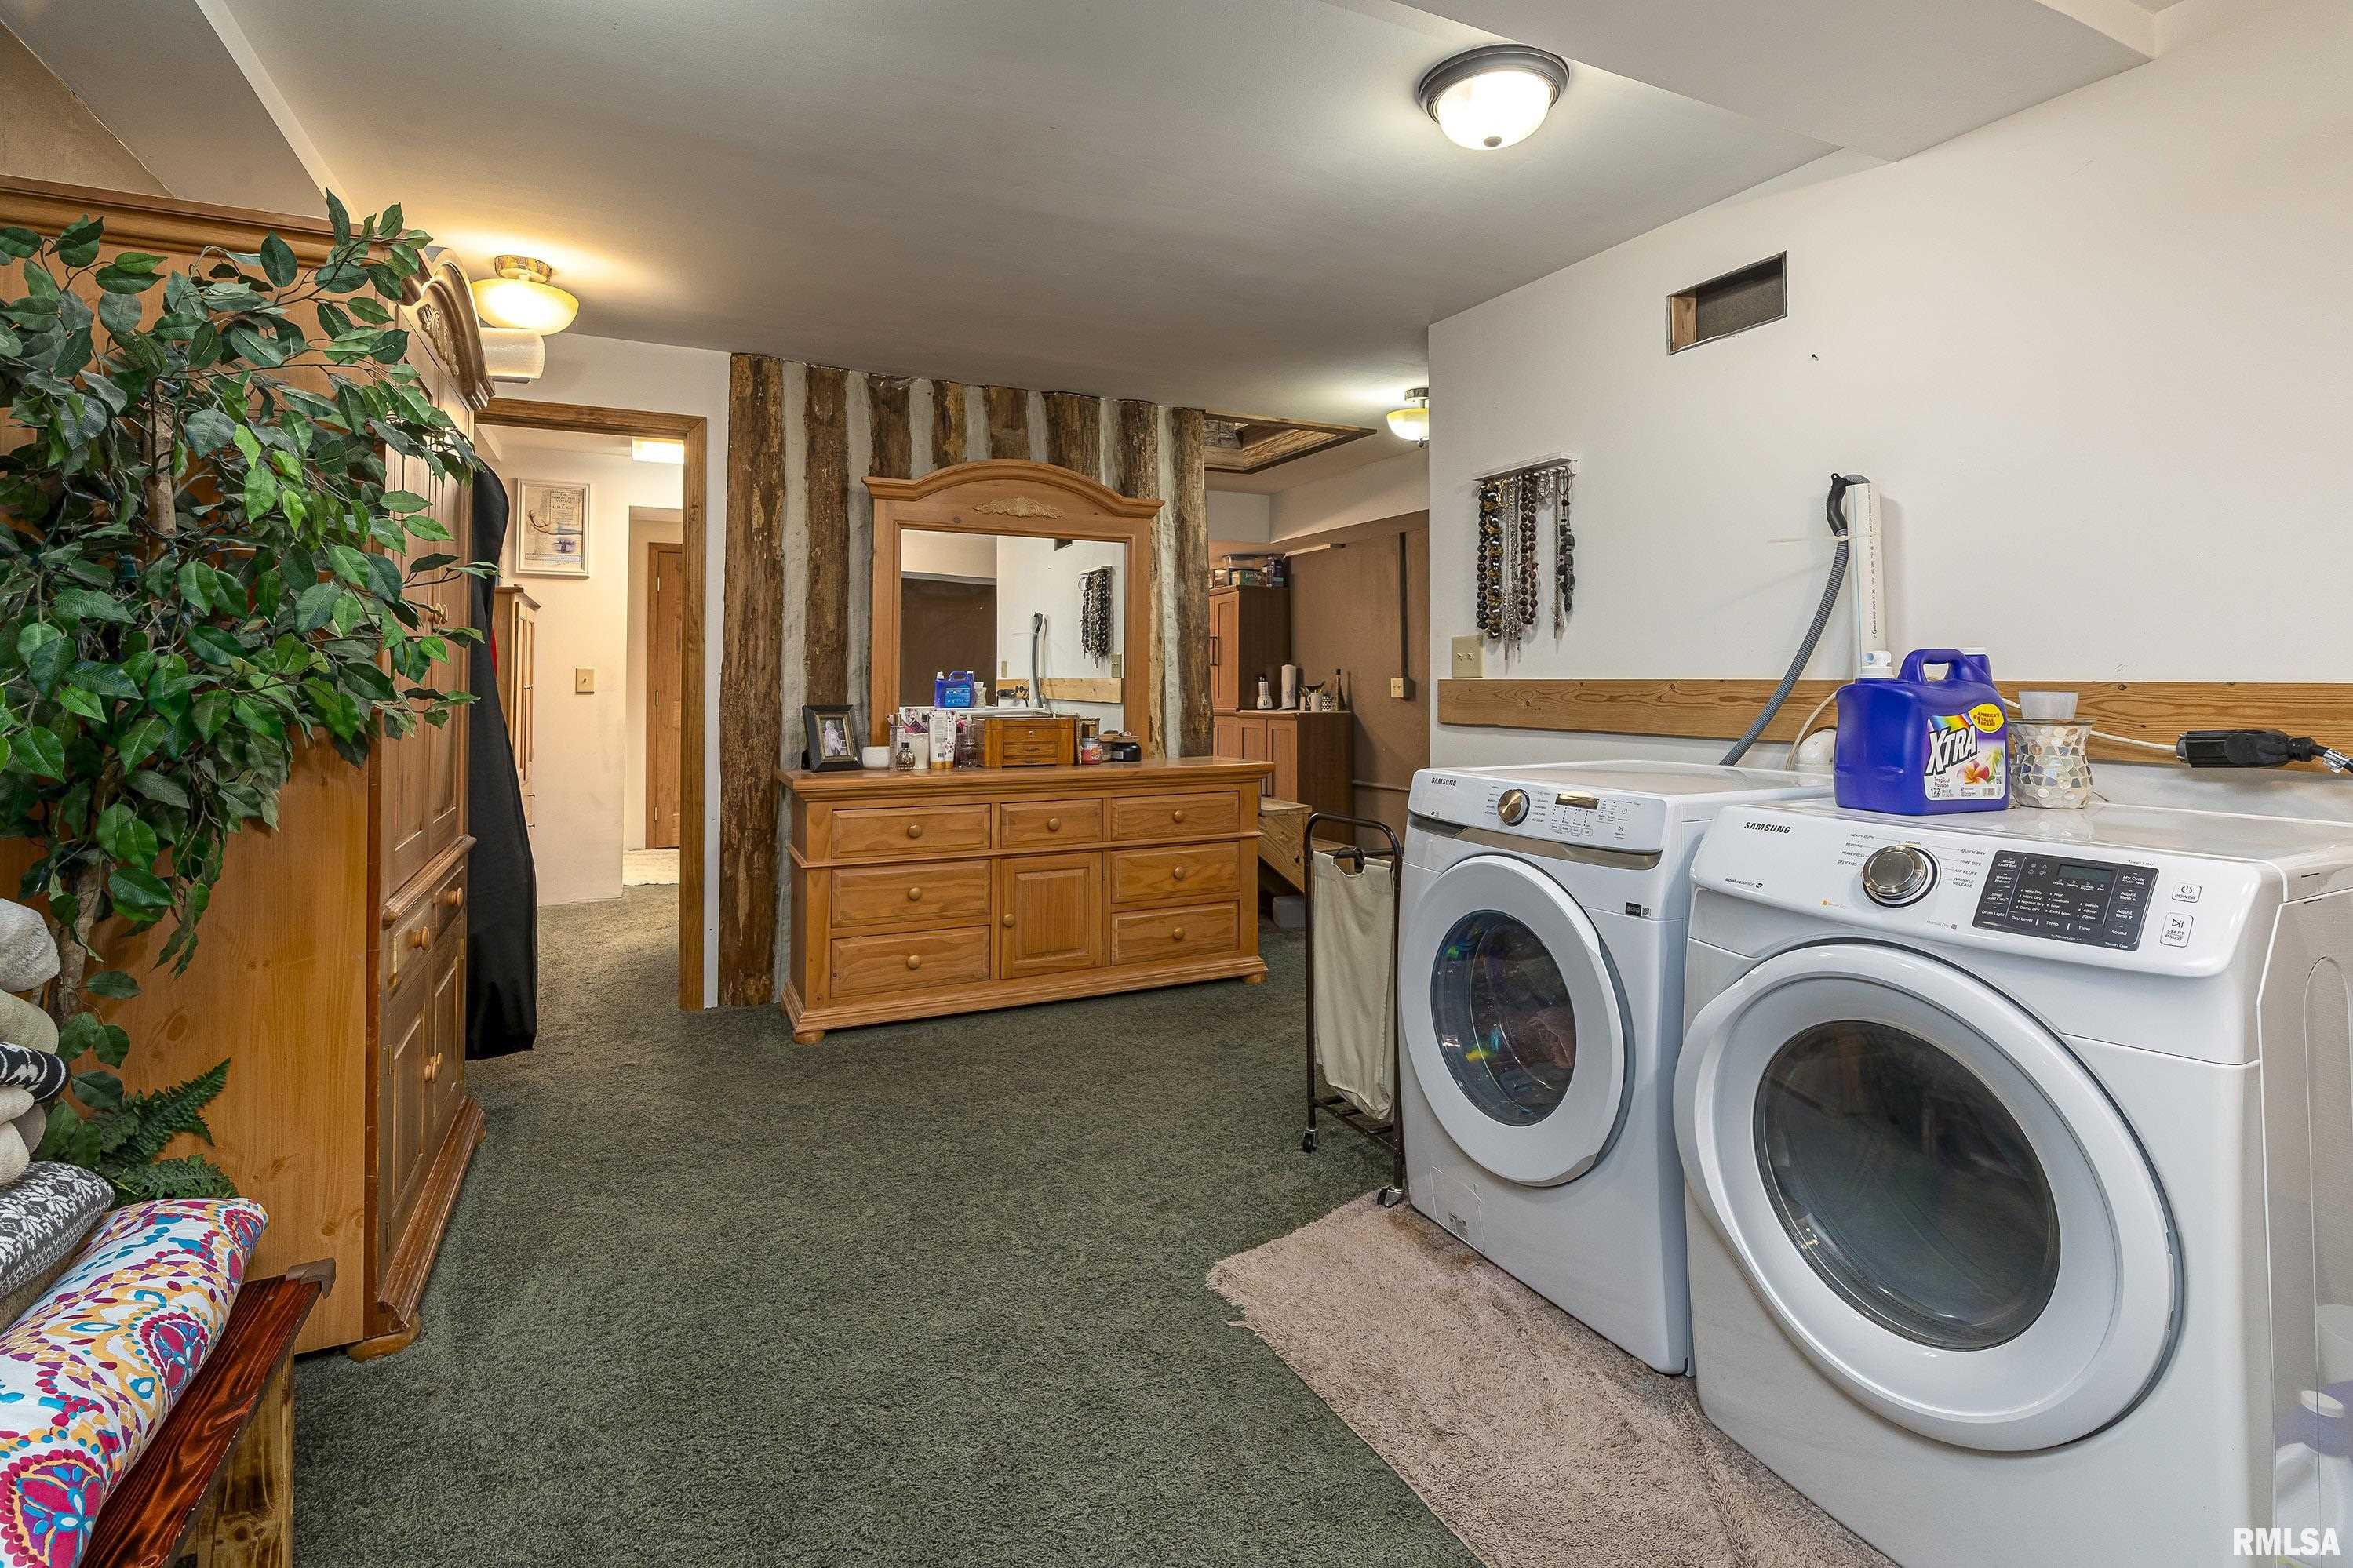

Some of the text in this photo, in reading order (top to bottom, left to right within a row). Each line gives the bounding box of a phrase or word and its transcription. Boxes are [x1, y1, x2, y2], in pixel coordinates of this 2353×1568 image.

[1925, 724, 1978, 776] XTRA
[1431, 777, 1457, 786] SAMSUNG
[1744, 821, 1791, 834] SAMSUNG
